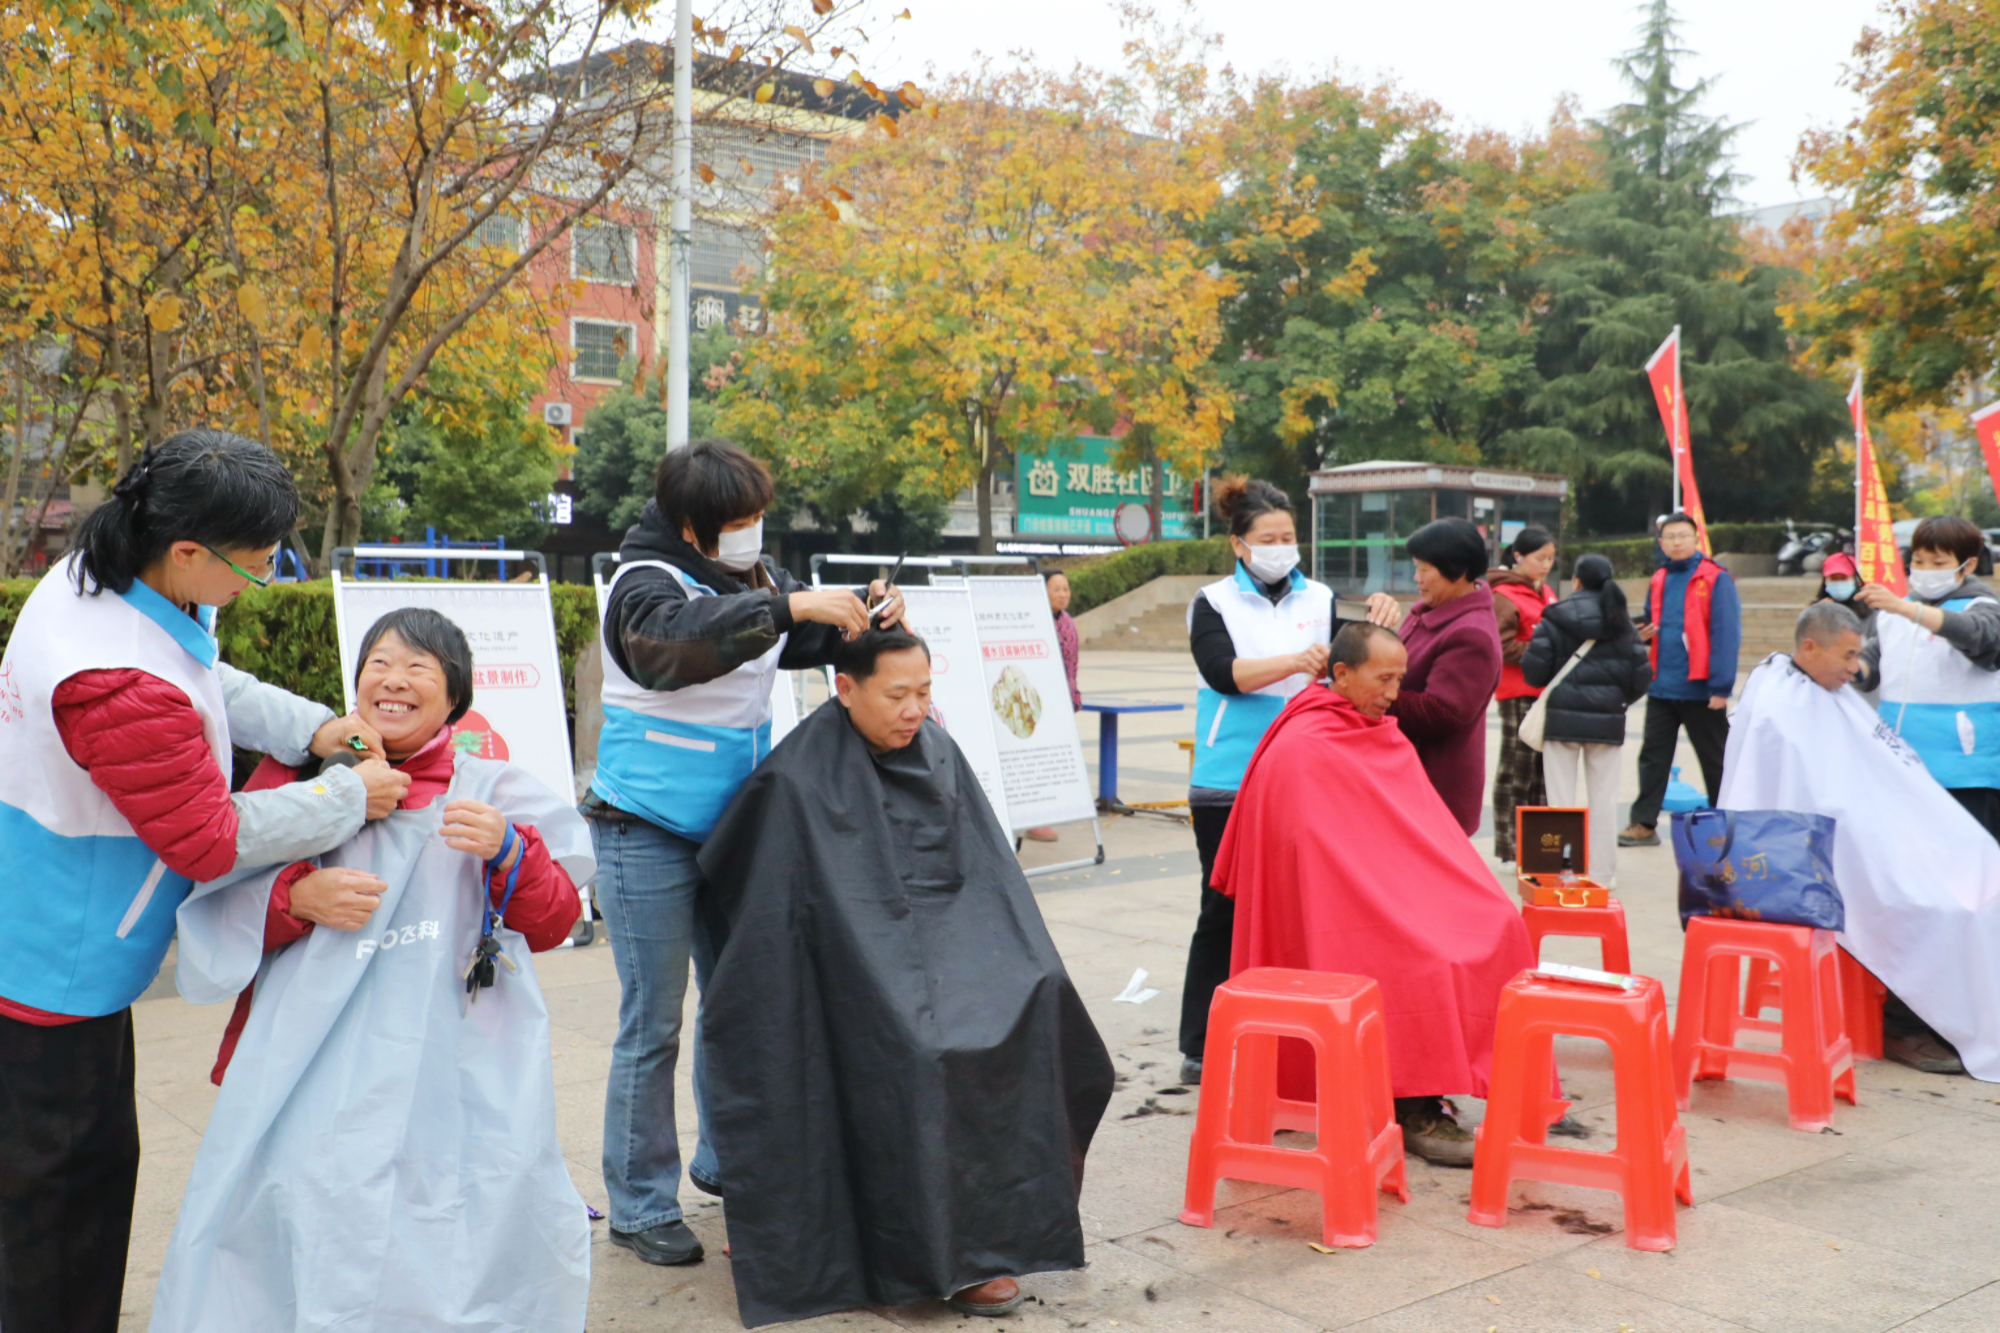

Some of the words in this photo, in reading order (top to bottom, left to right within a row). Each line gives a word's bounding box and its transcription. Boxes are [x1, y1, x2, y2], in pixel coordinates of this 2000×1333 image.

[1069, 506, 1117, 518] SHUANGS
[467, 630, 519, 642] 文化遗产
[473, 669, 529, 686] 盆景制作
